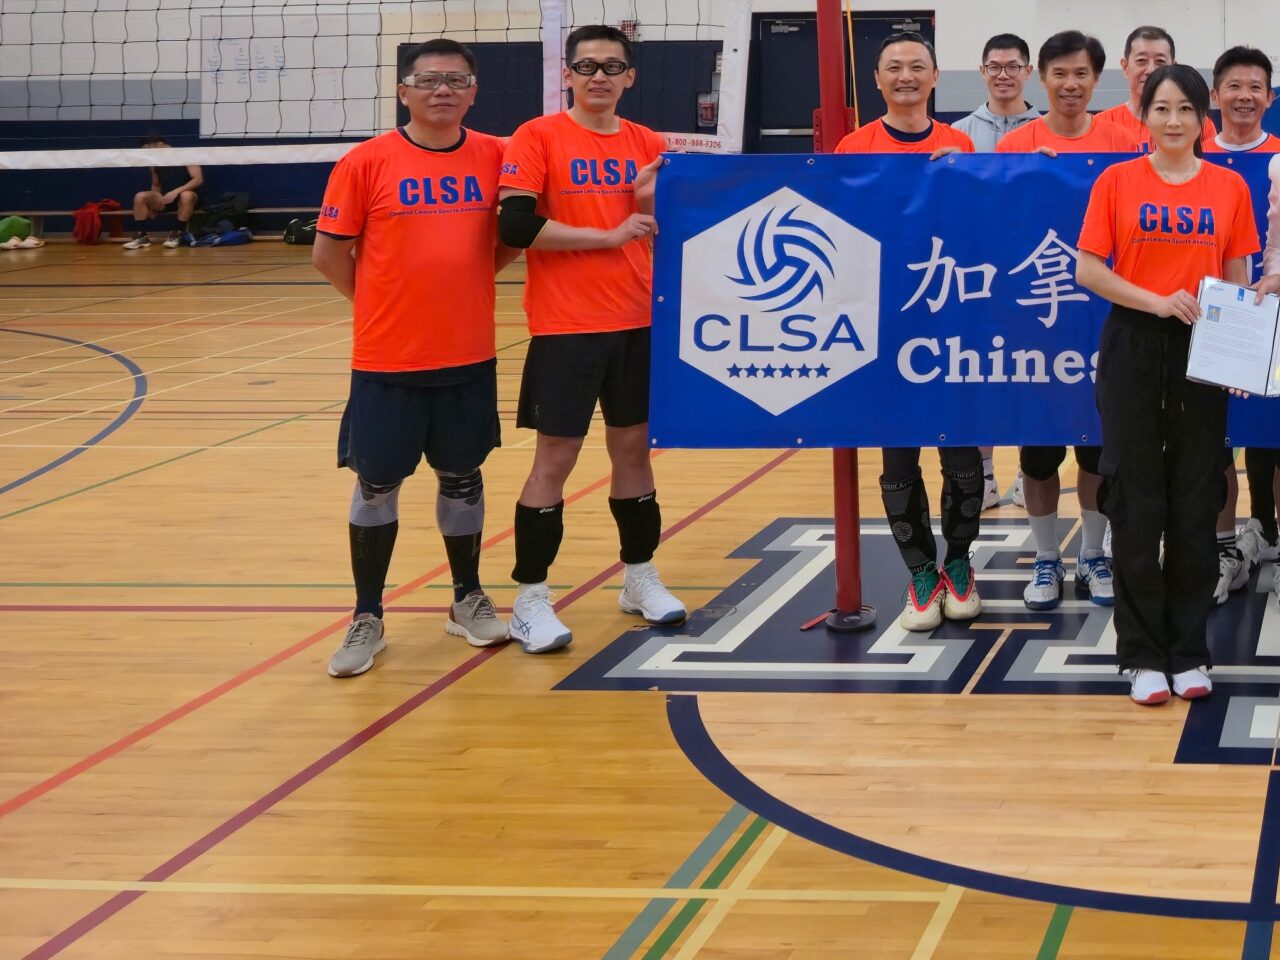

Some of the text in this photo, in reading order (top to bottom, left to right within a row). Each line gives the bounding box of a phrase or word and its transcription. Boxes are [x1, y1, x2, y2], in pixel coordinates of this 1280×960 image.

[570, 158, 638, 186] CLSA
[398, 175, 484, 206] CLSA
[1139, 203, 1215, 236] CLSA
[693, 314, 865, 352] CLSA
